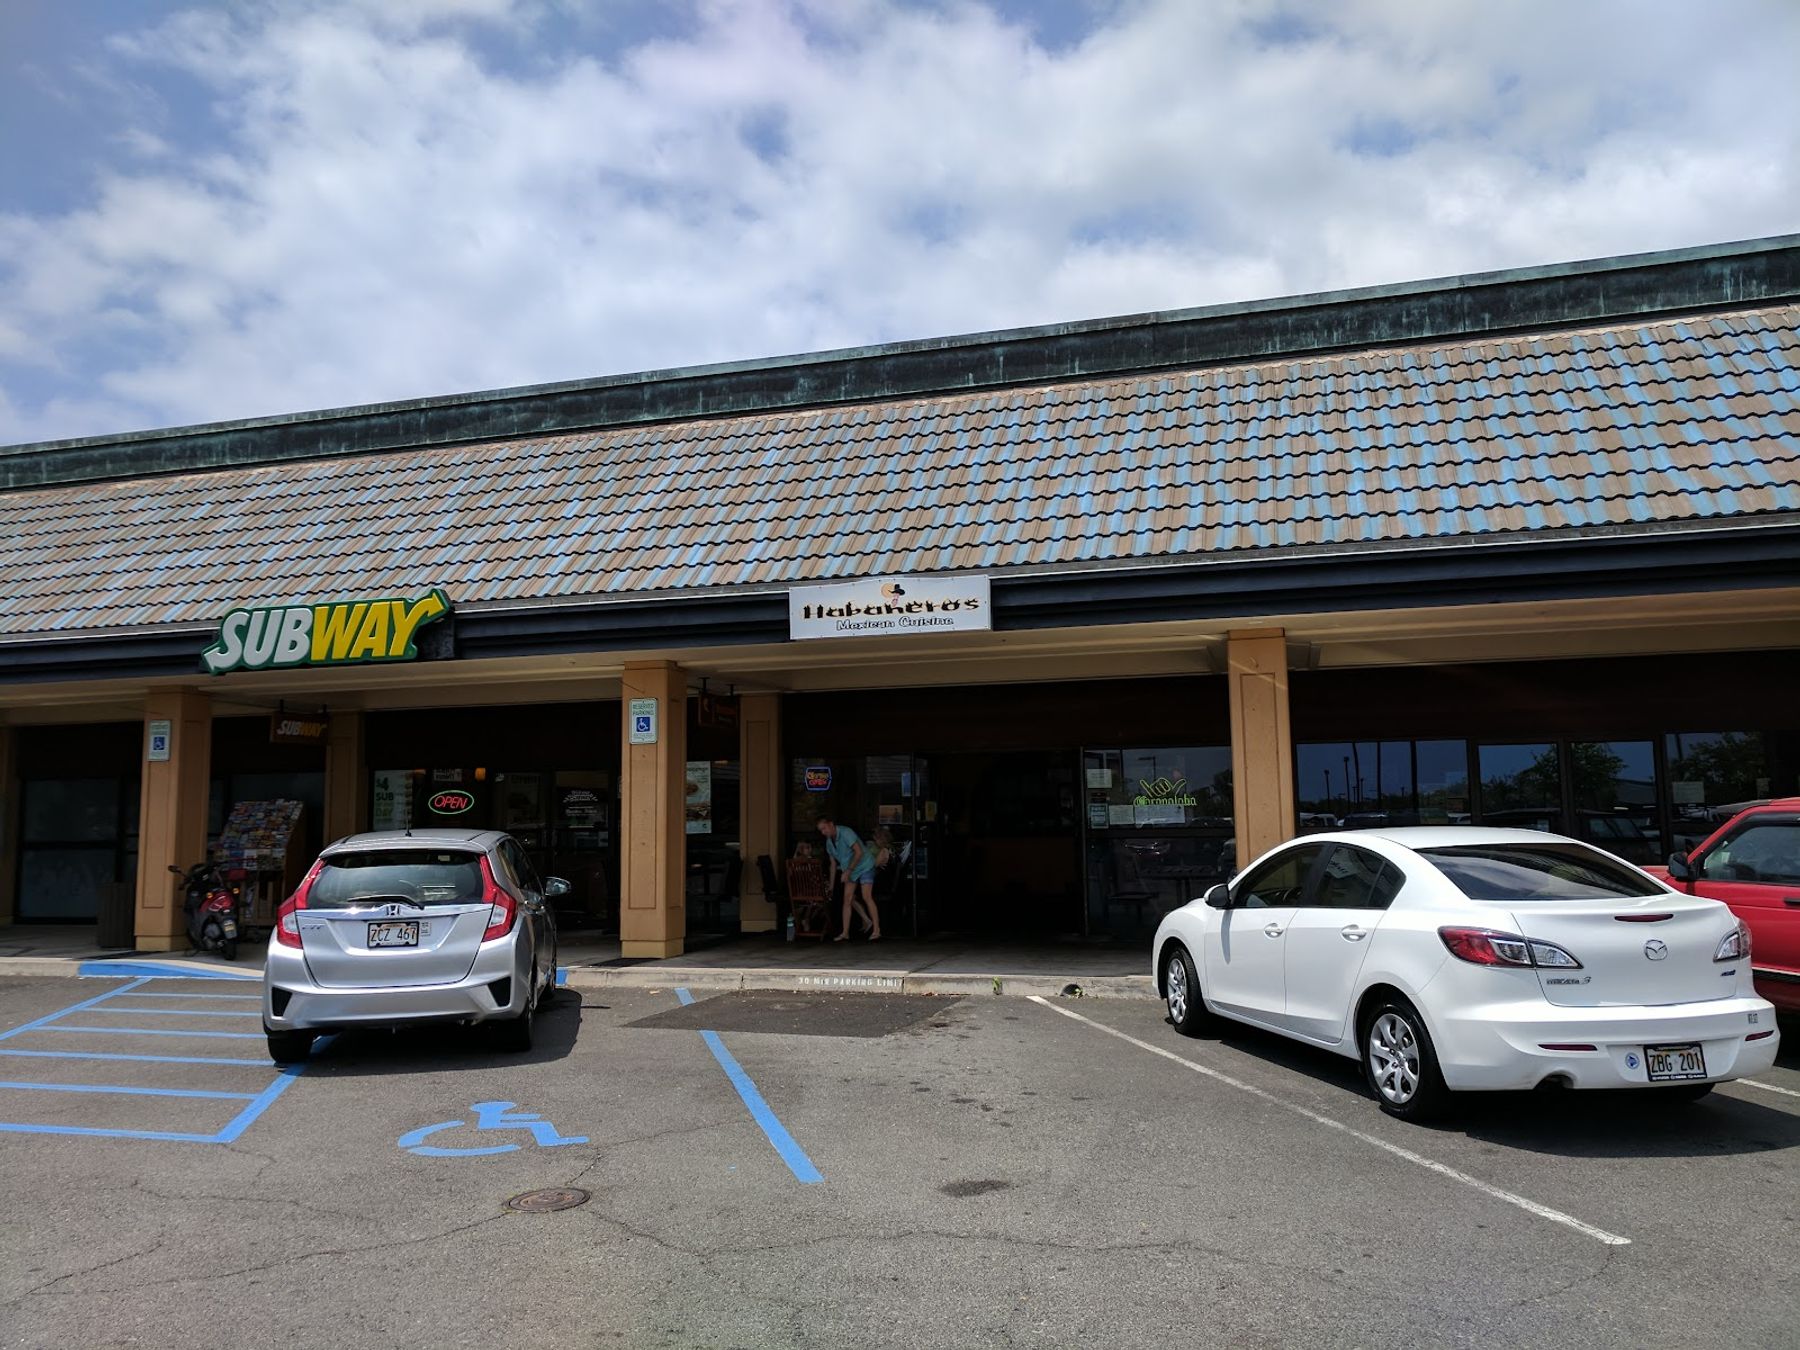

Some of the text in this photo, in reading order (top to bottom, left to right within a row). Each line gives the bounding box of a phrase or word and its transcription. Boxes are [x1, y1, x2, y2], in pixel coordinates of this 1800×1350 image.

[803, 596, 980, 619] Habaneros
[836, 615, 955, 631] Mexican Cuisine
[204, 592, 444, 671] SUBWAY
[276, 719, 327, 737] SUBWAY
[375, 792, 394, 801] SUB
[434, 795, 468, 809] OPEN
[371, 928, 391, 942] ZCZ
[396, 928, 417, 941] 467
[833, 978, 873, 986] PARKING
[877, 979, 904, 987] LIMIT
[1649, 1052, 1701, 1073] ZBG 201
